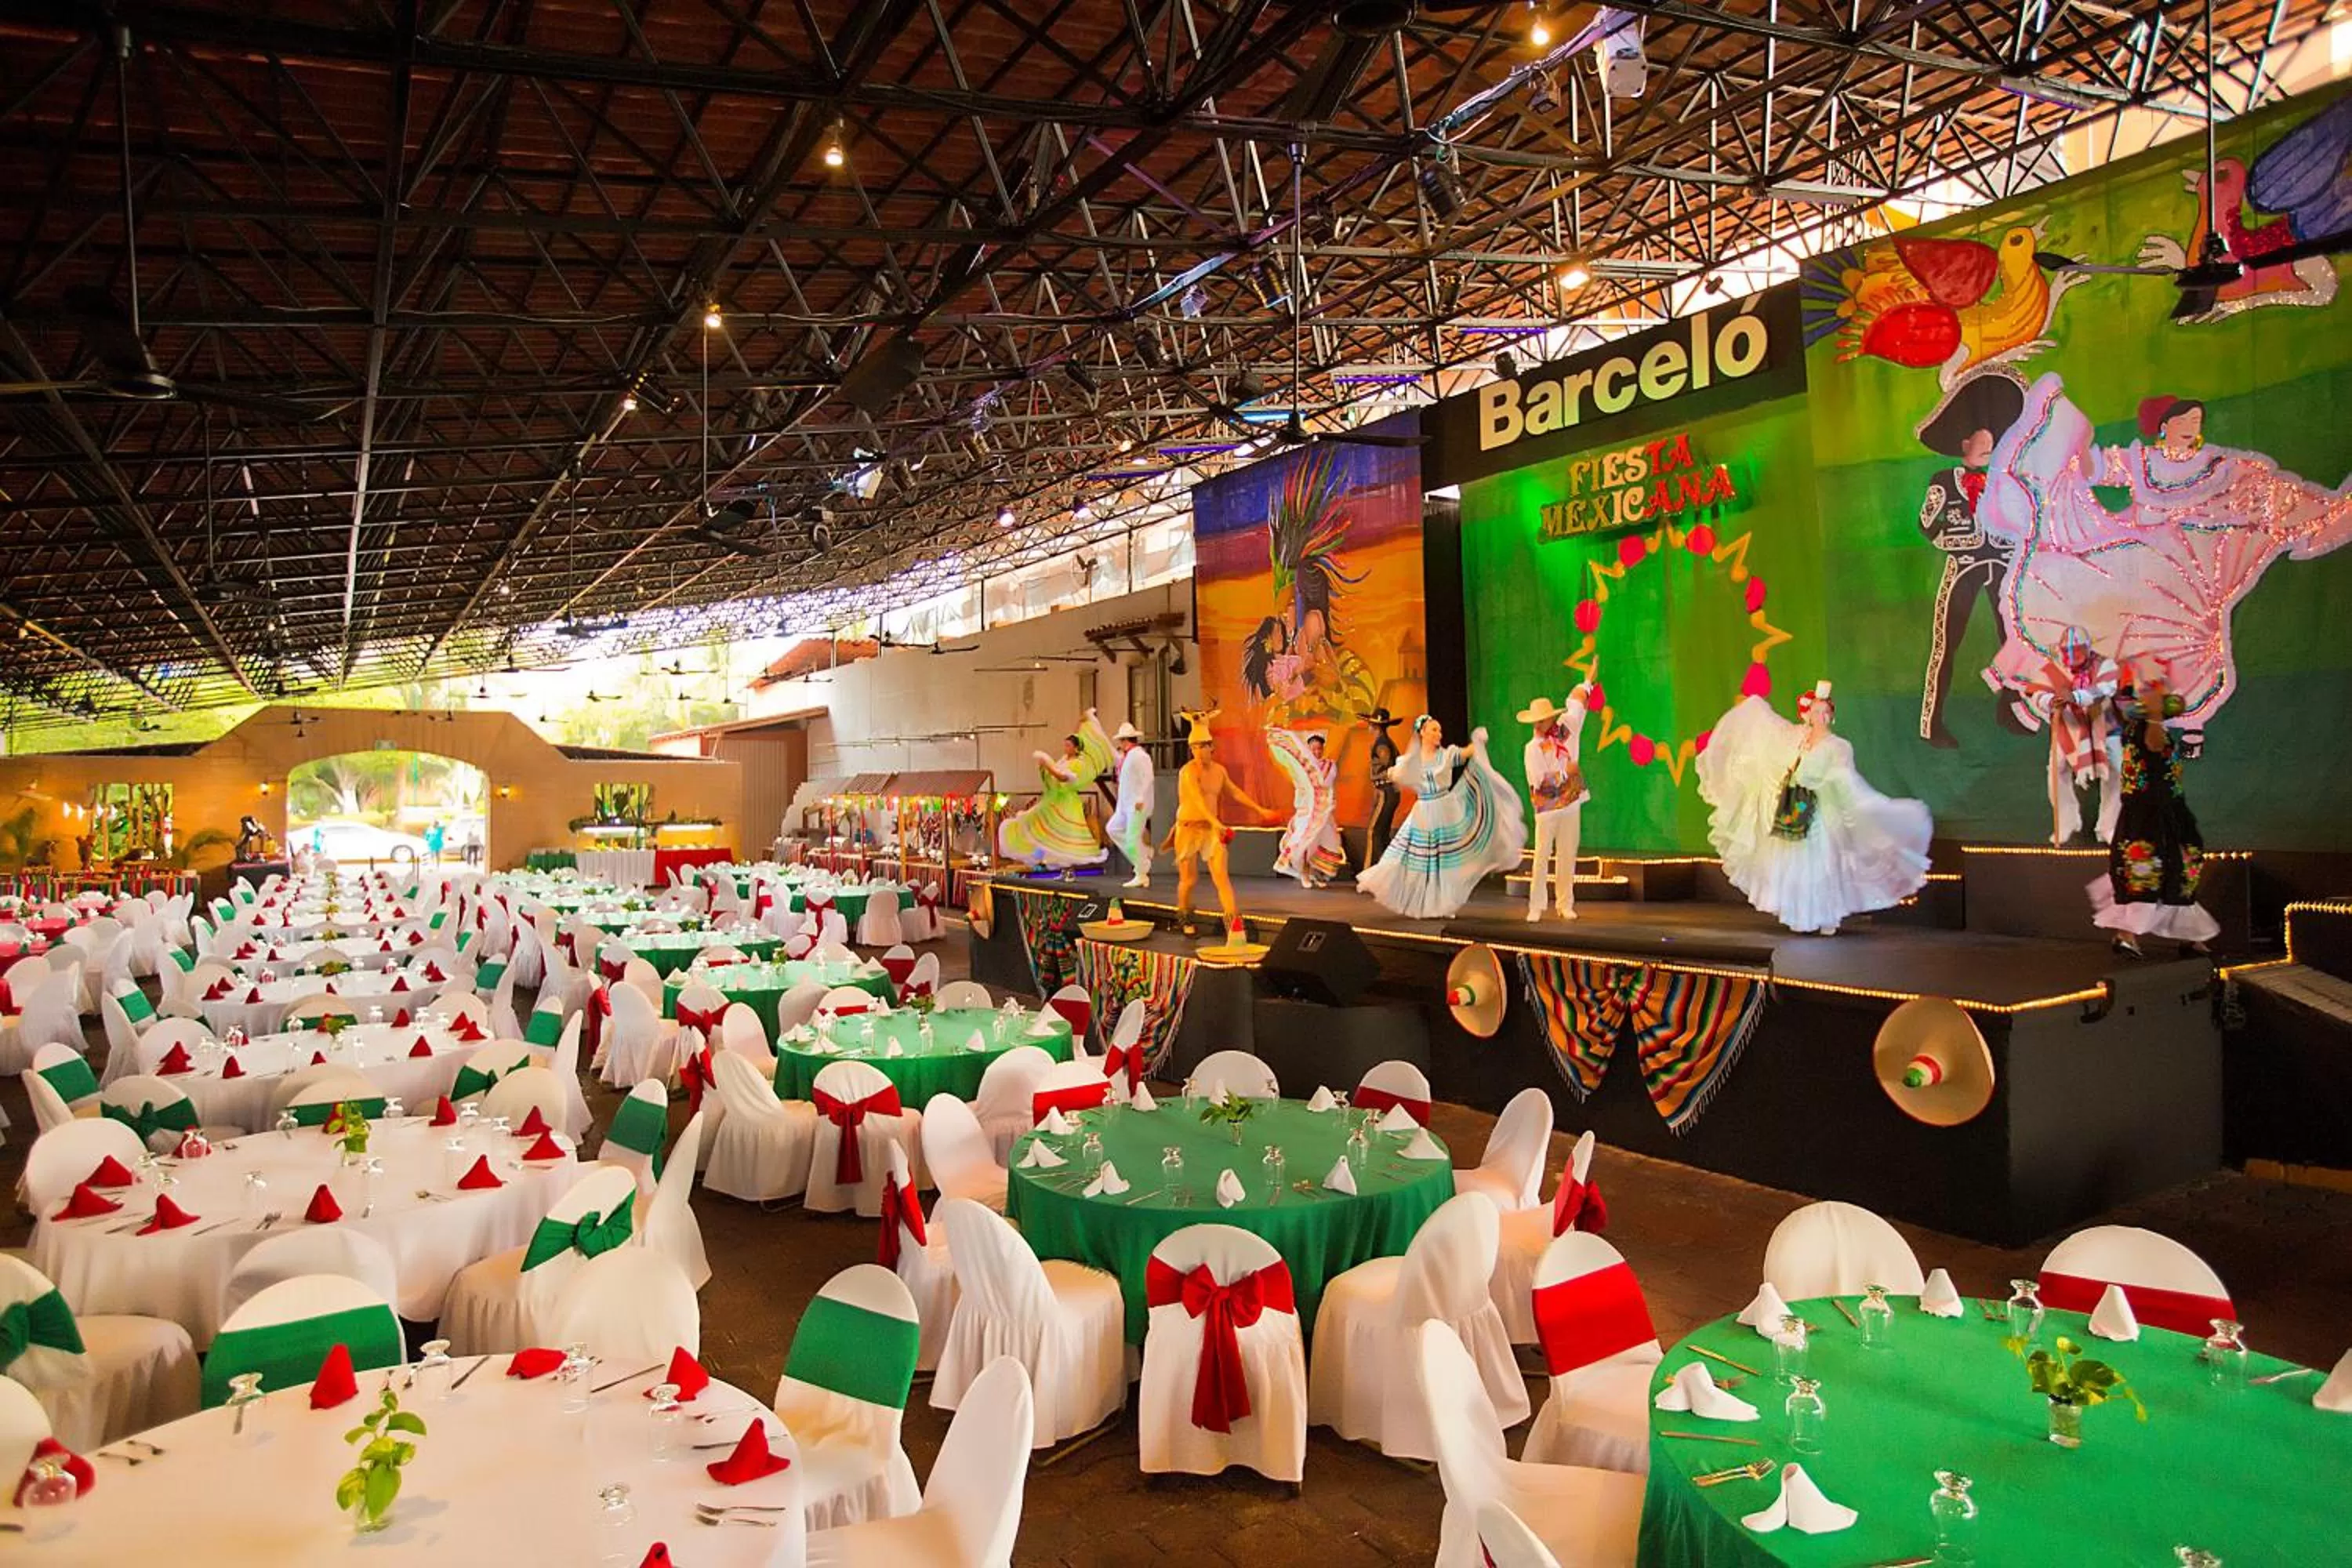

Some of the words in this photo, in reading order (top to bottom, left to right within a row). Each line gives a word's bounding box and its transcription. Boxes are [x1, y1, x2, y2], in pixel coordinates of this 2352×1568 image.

[1479, 292, 1767, 452] Barceló
[1541, 464, 1735, 537] MEXICANA
[1569, 434, 1693, 495] FIESTA
